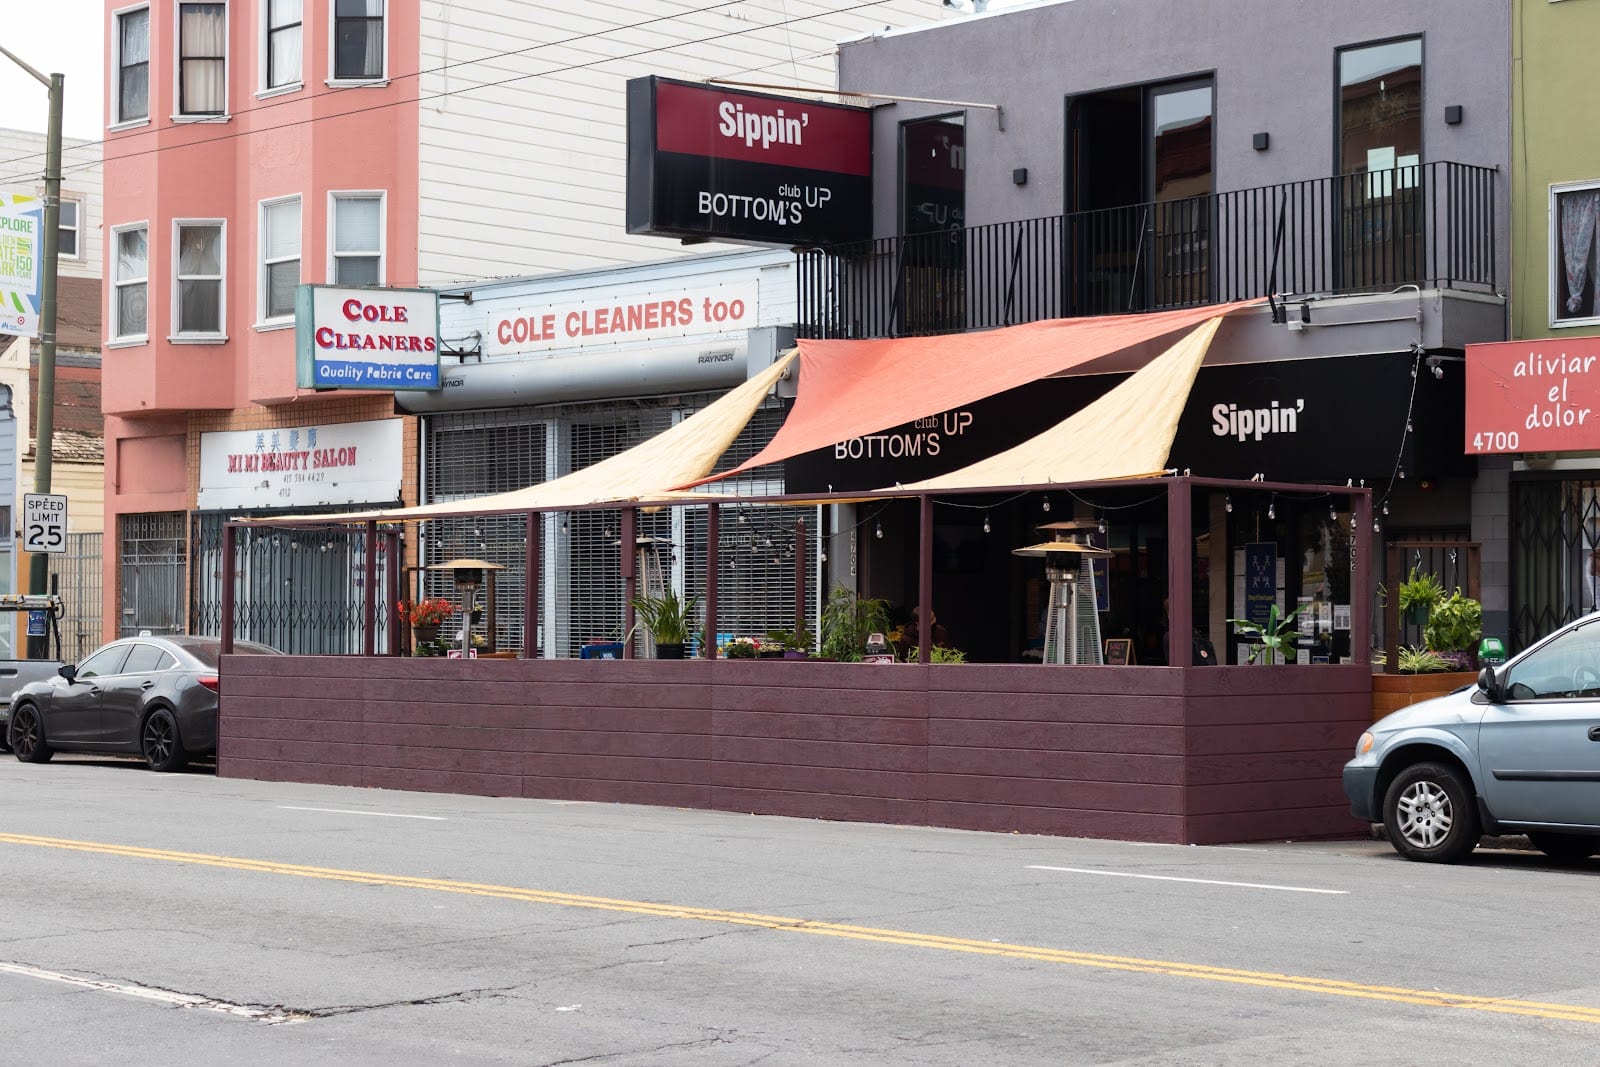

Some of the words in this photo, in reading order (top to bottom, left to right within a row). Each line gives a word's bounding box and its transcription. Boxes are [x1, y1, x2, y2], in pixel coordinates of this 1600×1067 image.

[718, 101, 809, 149] Sippin'
[698, 191, 802, 225] BOTTOM'S
[778, 184, 801, 198] club
[805, 186, 832, 209] UP
[0, 261, 15, 278] RK
[16, 255, 33, 272] 150
[16, 271, 32, 280] YEARS
[342, 299, 408, 323] COLE
[497, 314, 555, 345] COLE
[565, 297, 693, 337] CLEANERS
[703, 296, 744, 323] too
[315, 327, 436, 352] CLEANERS
[698, 353, 734, 365] RAYNOR
[1513, 352, 1597, 377] aliviar
[320, 365, 363, 381] Quality
[367, 366, 402, 379] Fabric
[406, 367, 432, 380] Care
[442, 380, 464, 388] AYNOR
[1548, 377, 1568, 402] el
[914, 414, 939, 429] club
[943, 412, 973, 436] UP
[1212, 398, 1305, 442] Sippin'
[1525, 403, 1591, 430] dolor
[834, 432, 940, 460] BOTTOM'S
[1473, 431, 1519, 451] 4700
[227, 454, 242, 473] MI
[244, 453, 259, 472] MI
[261, 451, 310, 472] BEAUTY
[313, 446, 357, 468] SALON
[28, 500, 64, 511] SPEED
[32, 513, 60, 522] LIMIT
[29, 524, 62, 546] 25
